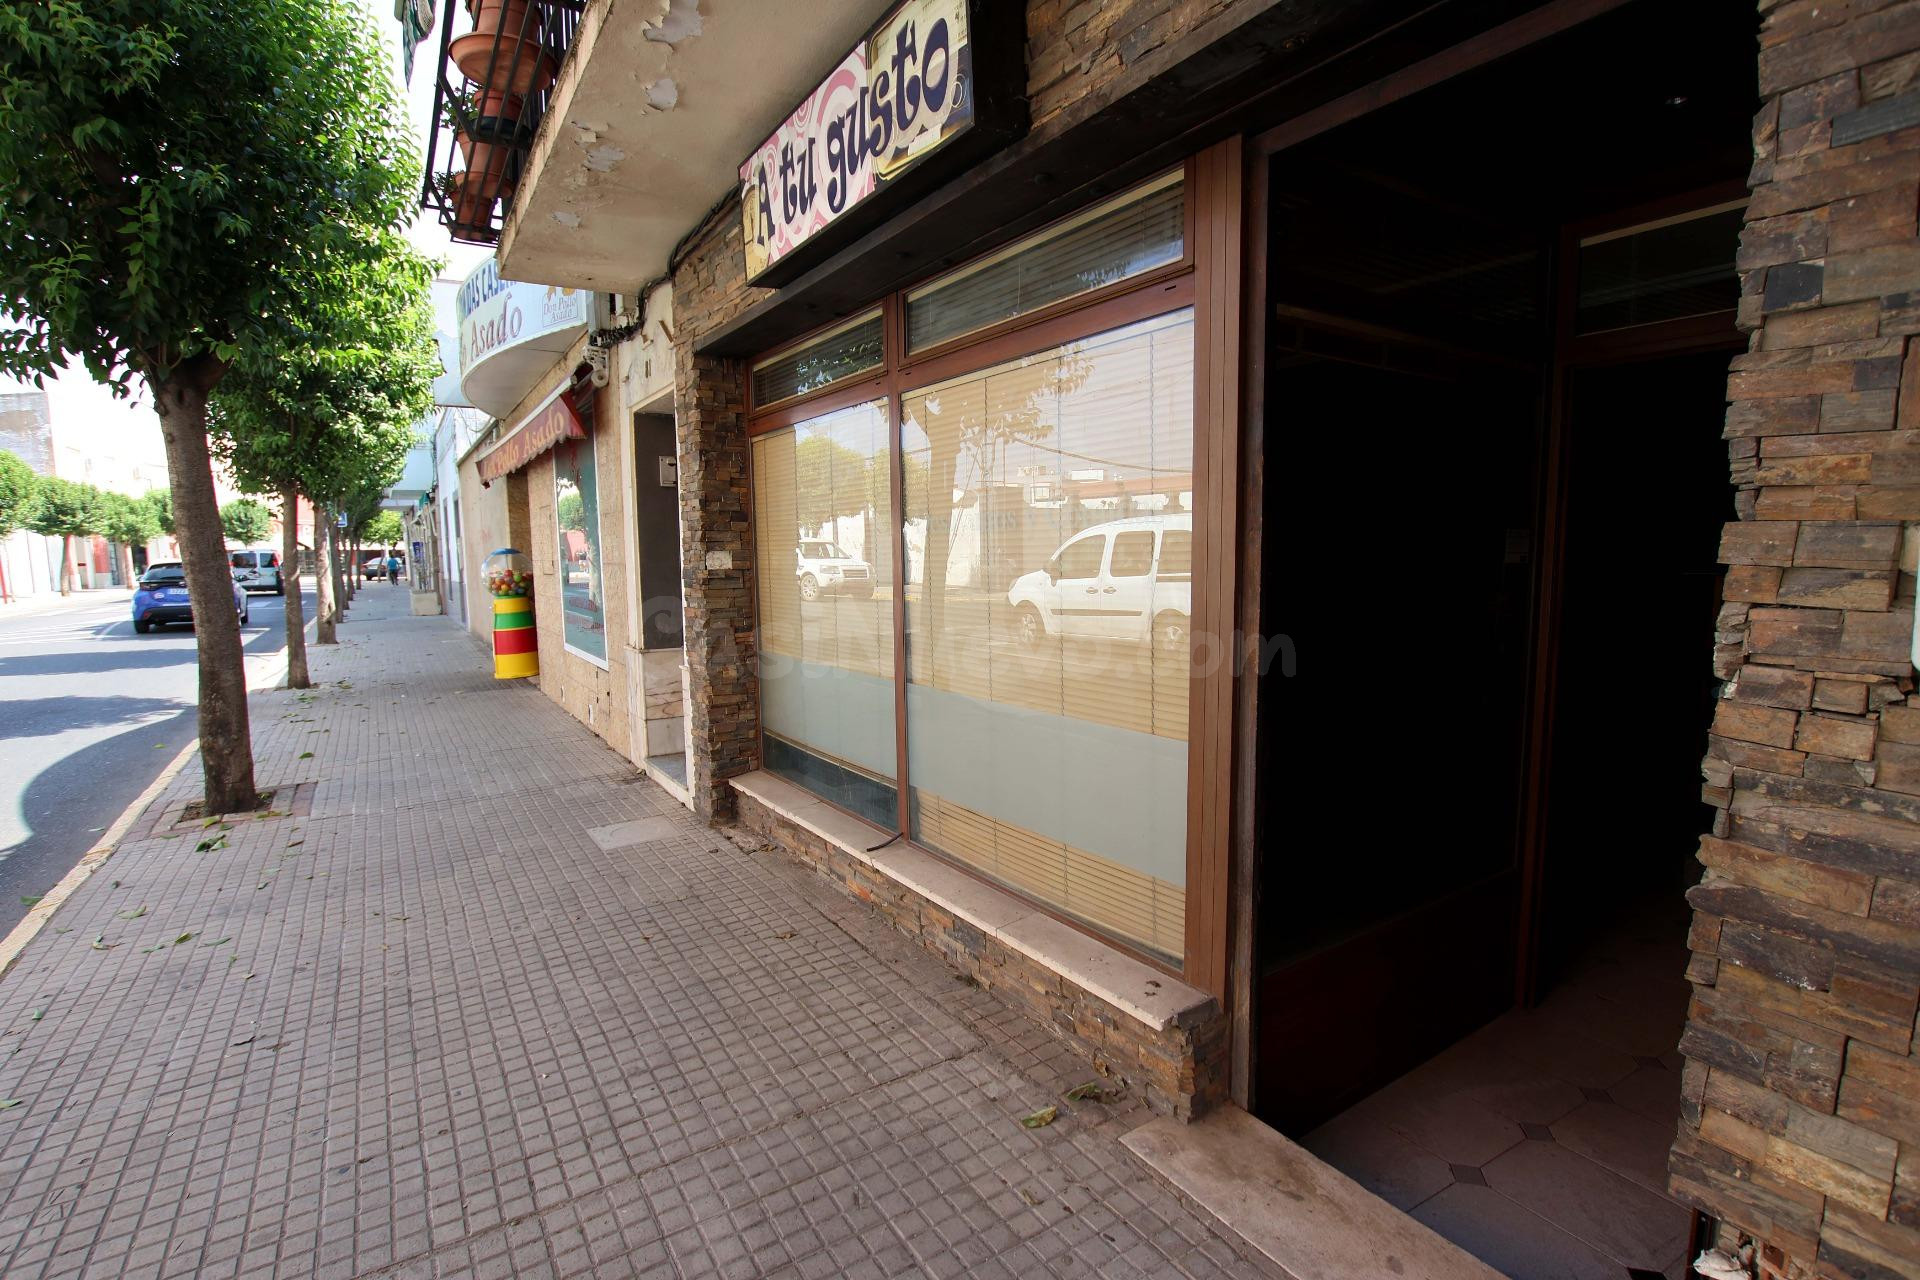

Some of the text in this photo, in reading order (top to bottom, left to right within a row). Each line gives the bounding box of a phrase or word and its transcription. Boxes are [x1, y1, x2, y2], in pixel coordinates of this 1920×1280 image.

[757, 17, 950, 246] A tu gusto
[471, 291, 522, 361] Asado
[523, 407, 565, 459] Asado
